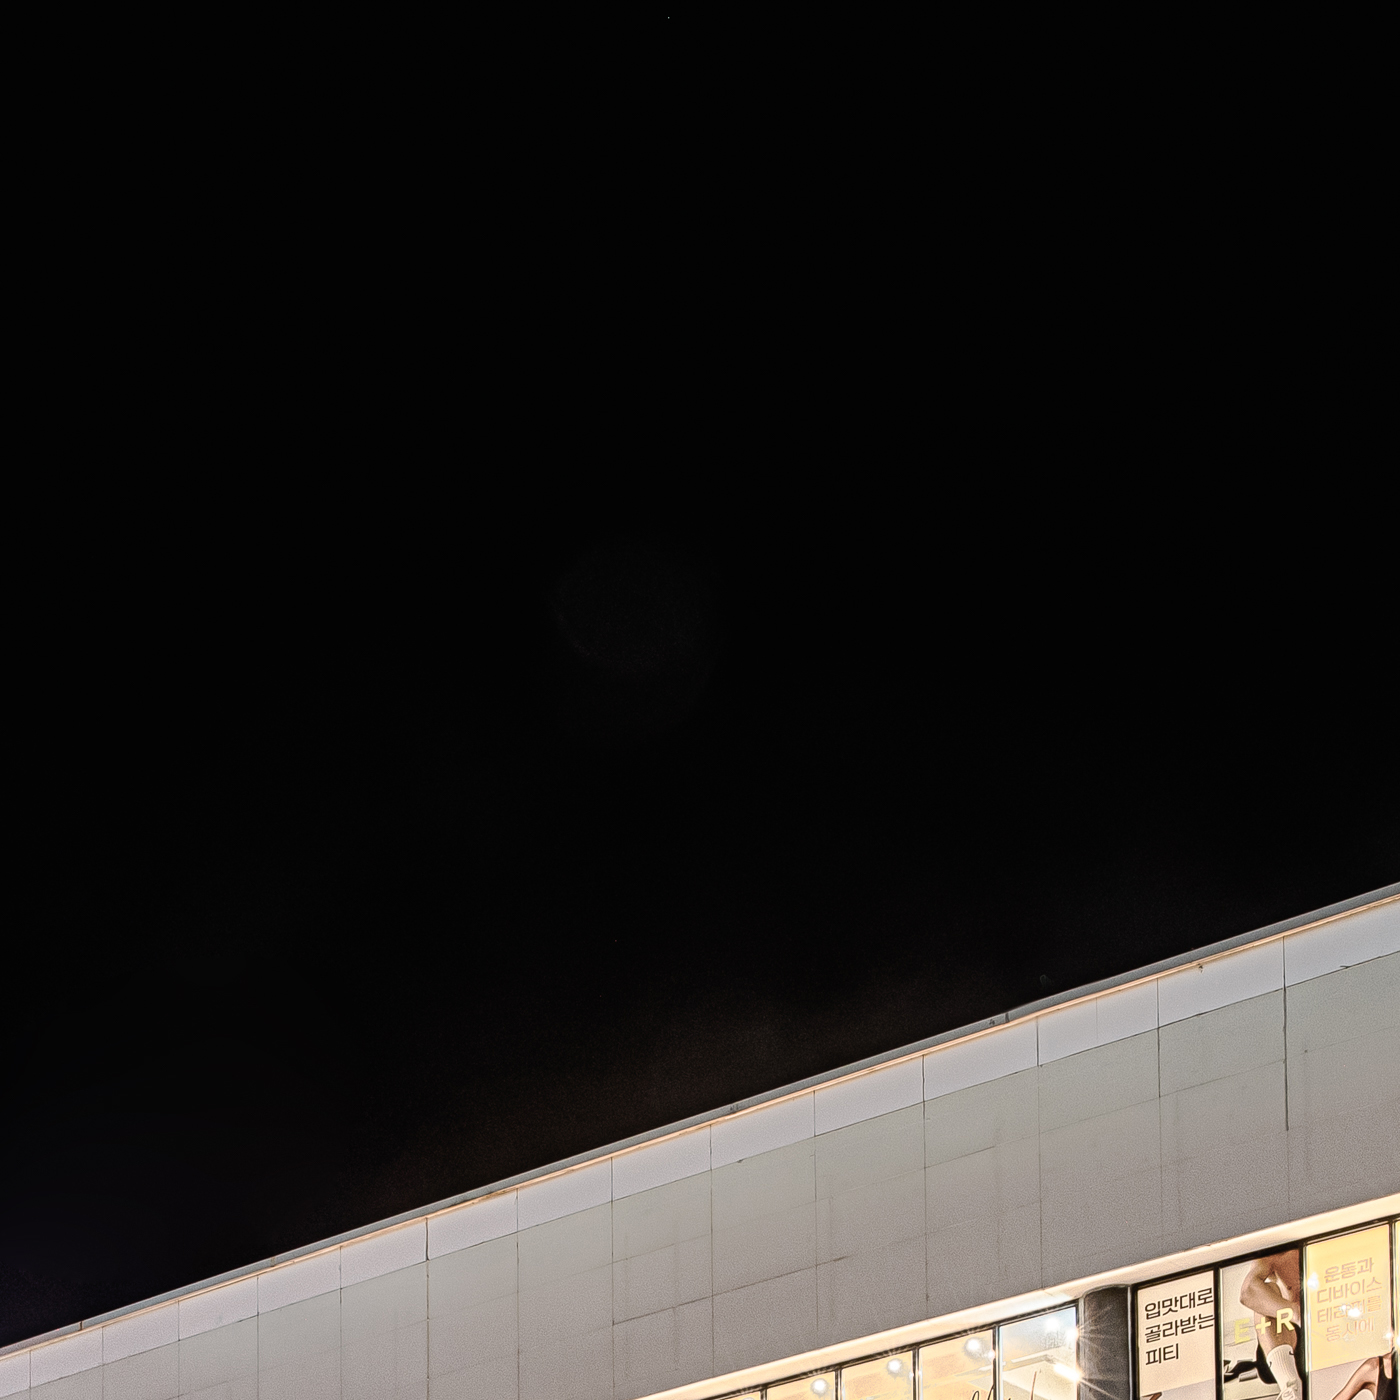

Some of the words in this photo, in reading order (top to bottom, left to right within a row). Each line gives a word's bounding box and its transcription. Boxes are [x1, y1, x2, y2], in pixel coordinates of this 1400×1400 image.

[1324, 1257, 1374, 1283] 운동과
[1317, 1276, 1383, 1303] 디바이스
[1144, 1288, 1214, 1320] 입맛대로
[1144, 1313, 1215, 1343] 골라받는
[1234, 1307, 1294, 1344] E+R
[1325, 1317, 1374, 1342] 동시에
[1145, 1343, 1180, 1366] 피티
